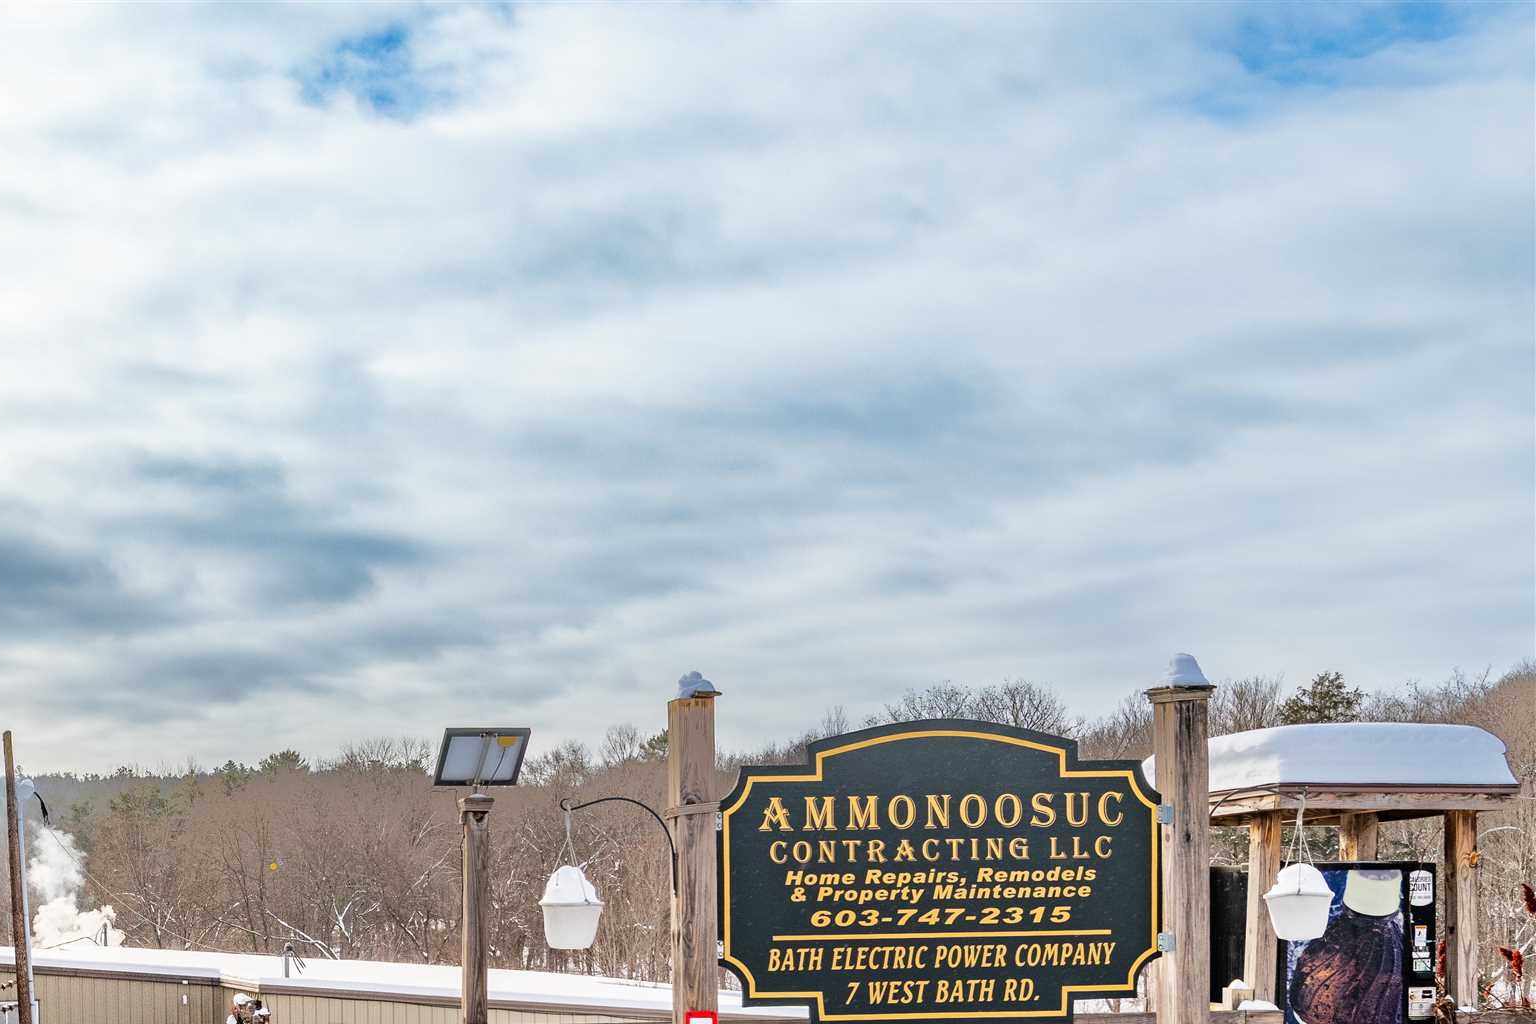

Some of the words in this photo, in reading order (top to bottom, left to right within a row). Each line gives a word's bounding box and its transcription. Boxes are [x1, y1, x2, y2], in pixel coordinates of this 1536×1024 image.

[758, 791, 1124, 832] AMMONOOSUC
[769, 837, 1030, 864] CONTRACTING
[1049, 835, 1113, 861] LLC
[785, 870, 856, 886] Home
[865, 868, 967, 888] Repairs,
[976, 866, 1097, 883] Remodels
[790, 887, 807, 902] &
[817, 886, 924, 905] Property
[933, 884, 1092, 900] Maintenance
[810, 906, 1072, 927] 603-747-2315
[768, 947, 824, 972] BATH
[831, 945, 928, 971] ELECTRIC
[934, 944, 1007, 969] POWER
[1015, 942, 1116, 967] COMPANY
[845, 982, 860, 1005] 7
[868, 980, 930, 1004] WEST
[935, 979, 996, 1003] BATH
[1003, 978, 1040, 1002] RD.
